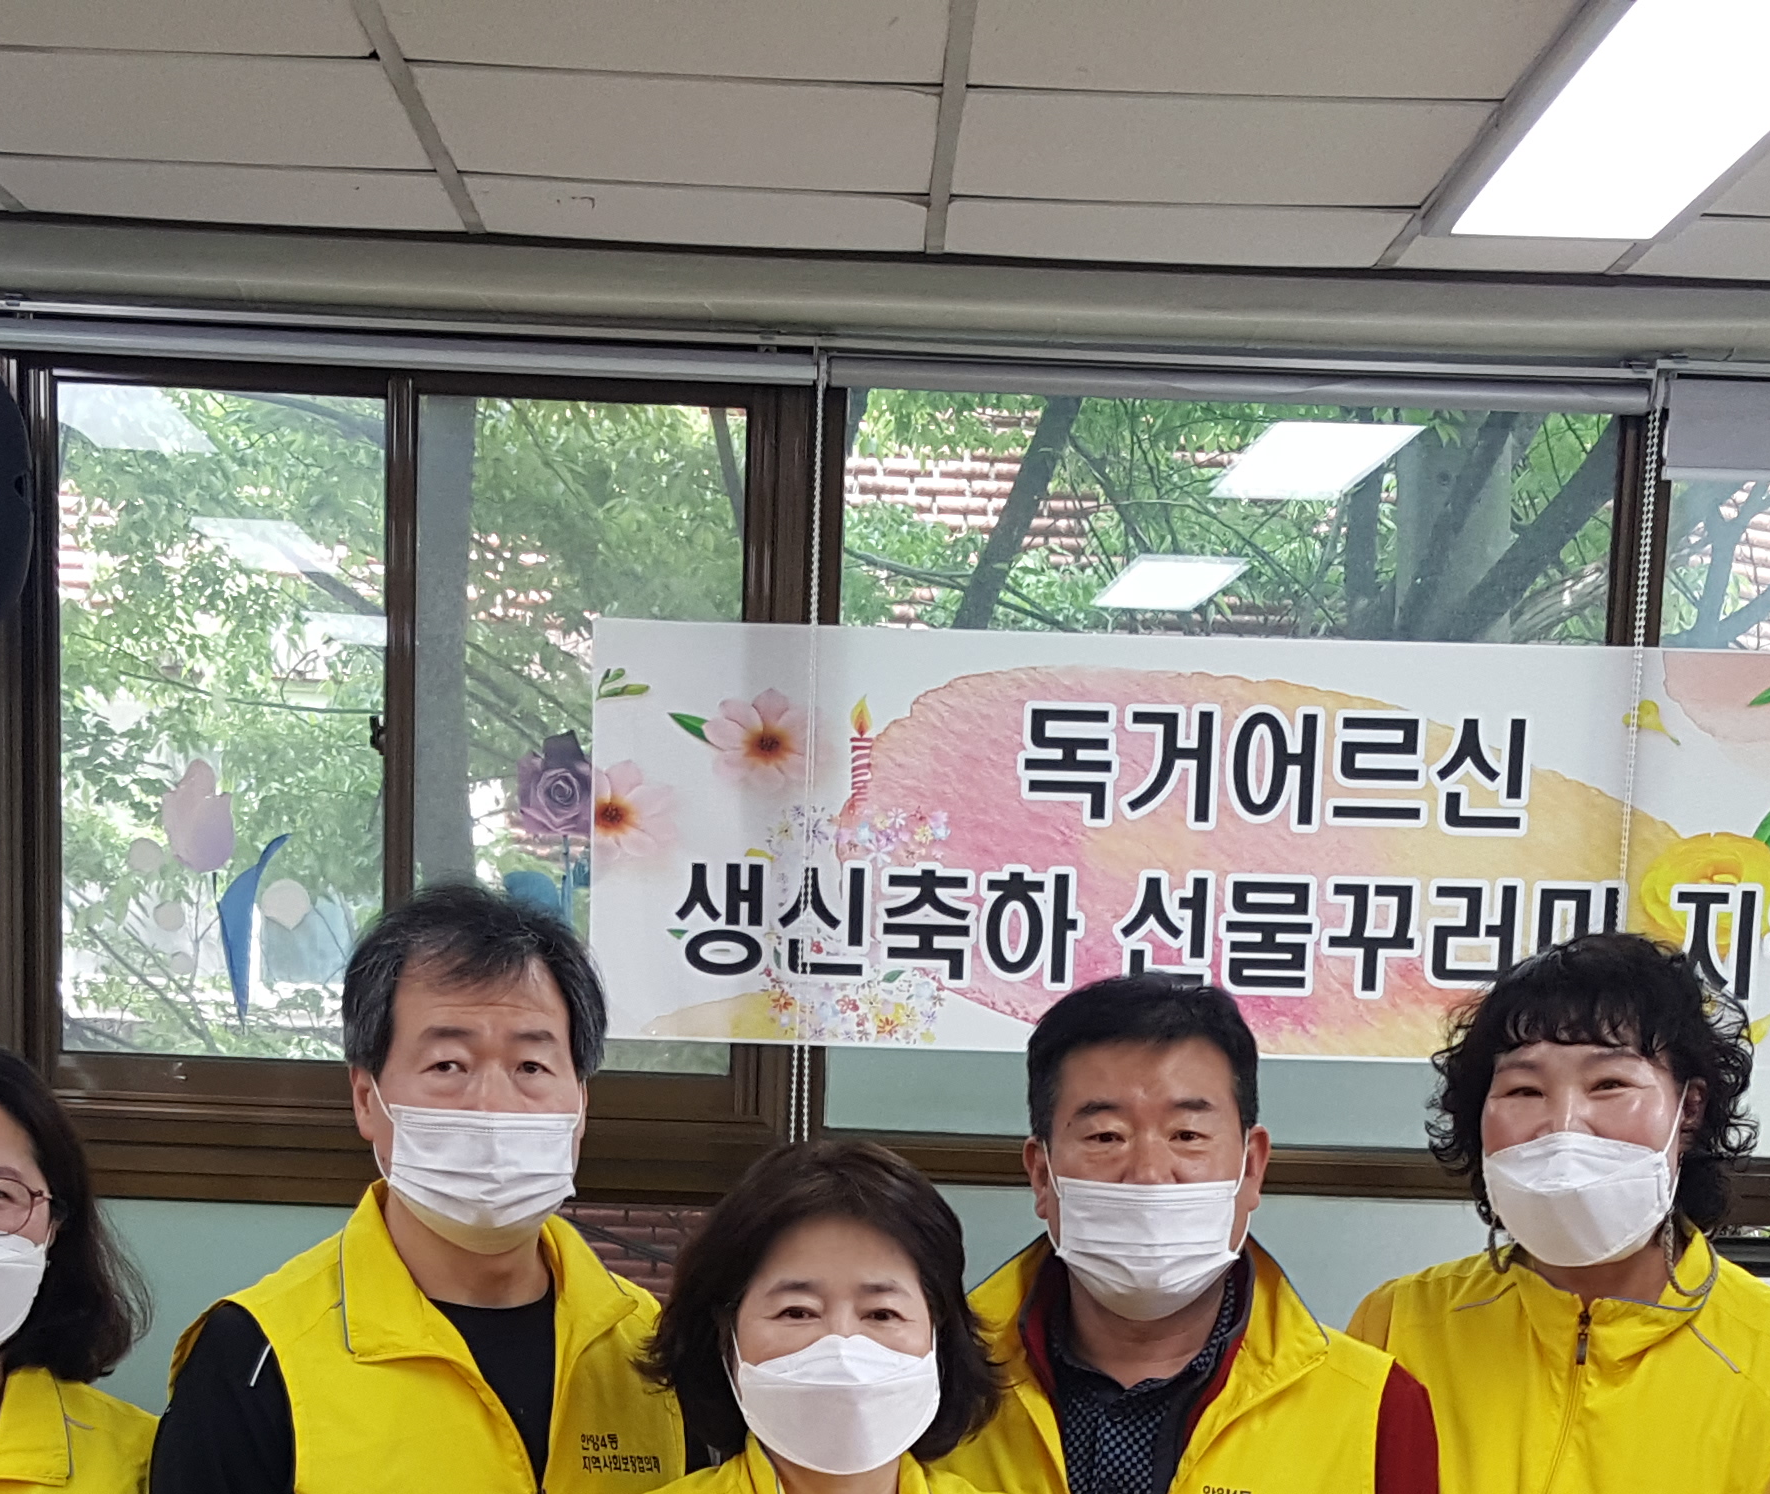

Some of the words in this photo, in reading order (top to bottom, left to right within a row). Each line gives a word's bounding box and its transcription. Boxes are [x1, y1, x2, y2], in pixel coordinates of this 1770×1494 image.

[1023, 704, 1527, 832] 독거어르신
[675, 861, 1077, 983] 생신축하
[1122, 876, 1619, 992] 선물꾸러미
[580, 1433, 619, 1451] 안양4동
[582, 1455, 661, 1474] 지역사회보장협의체
